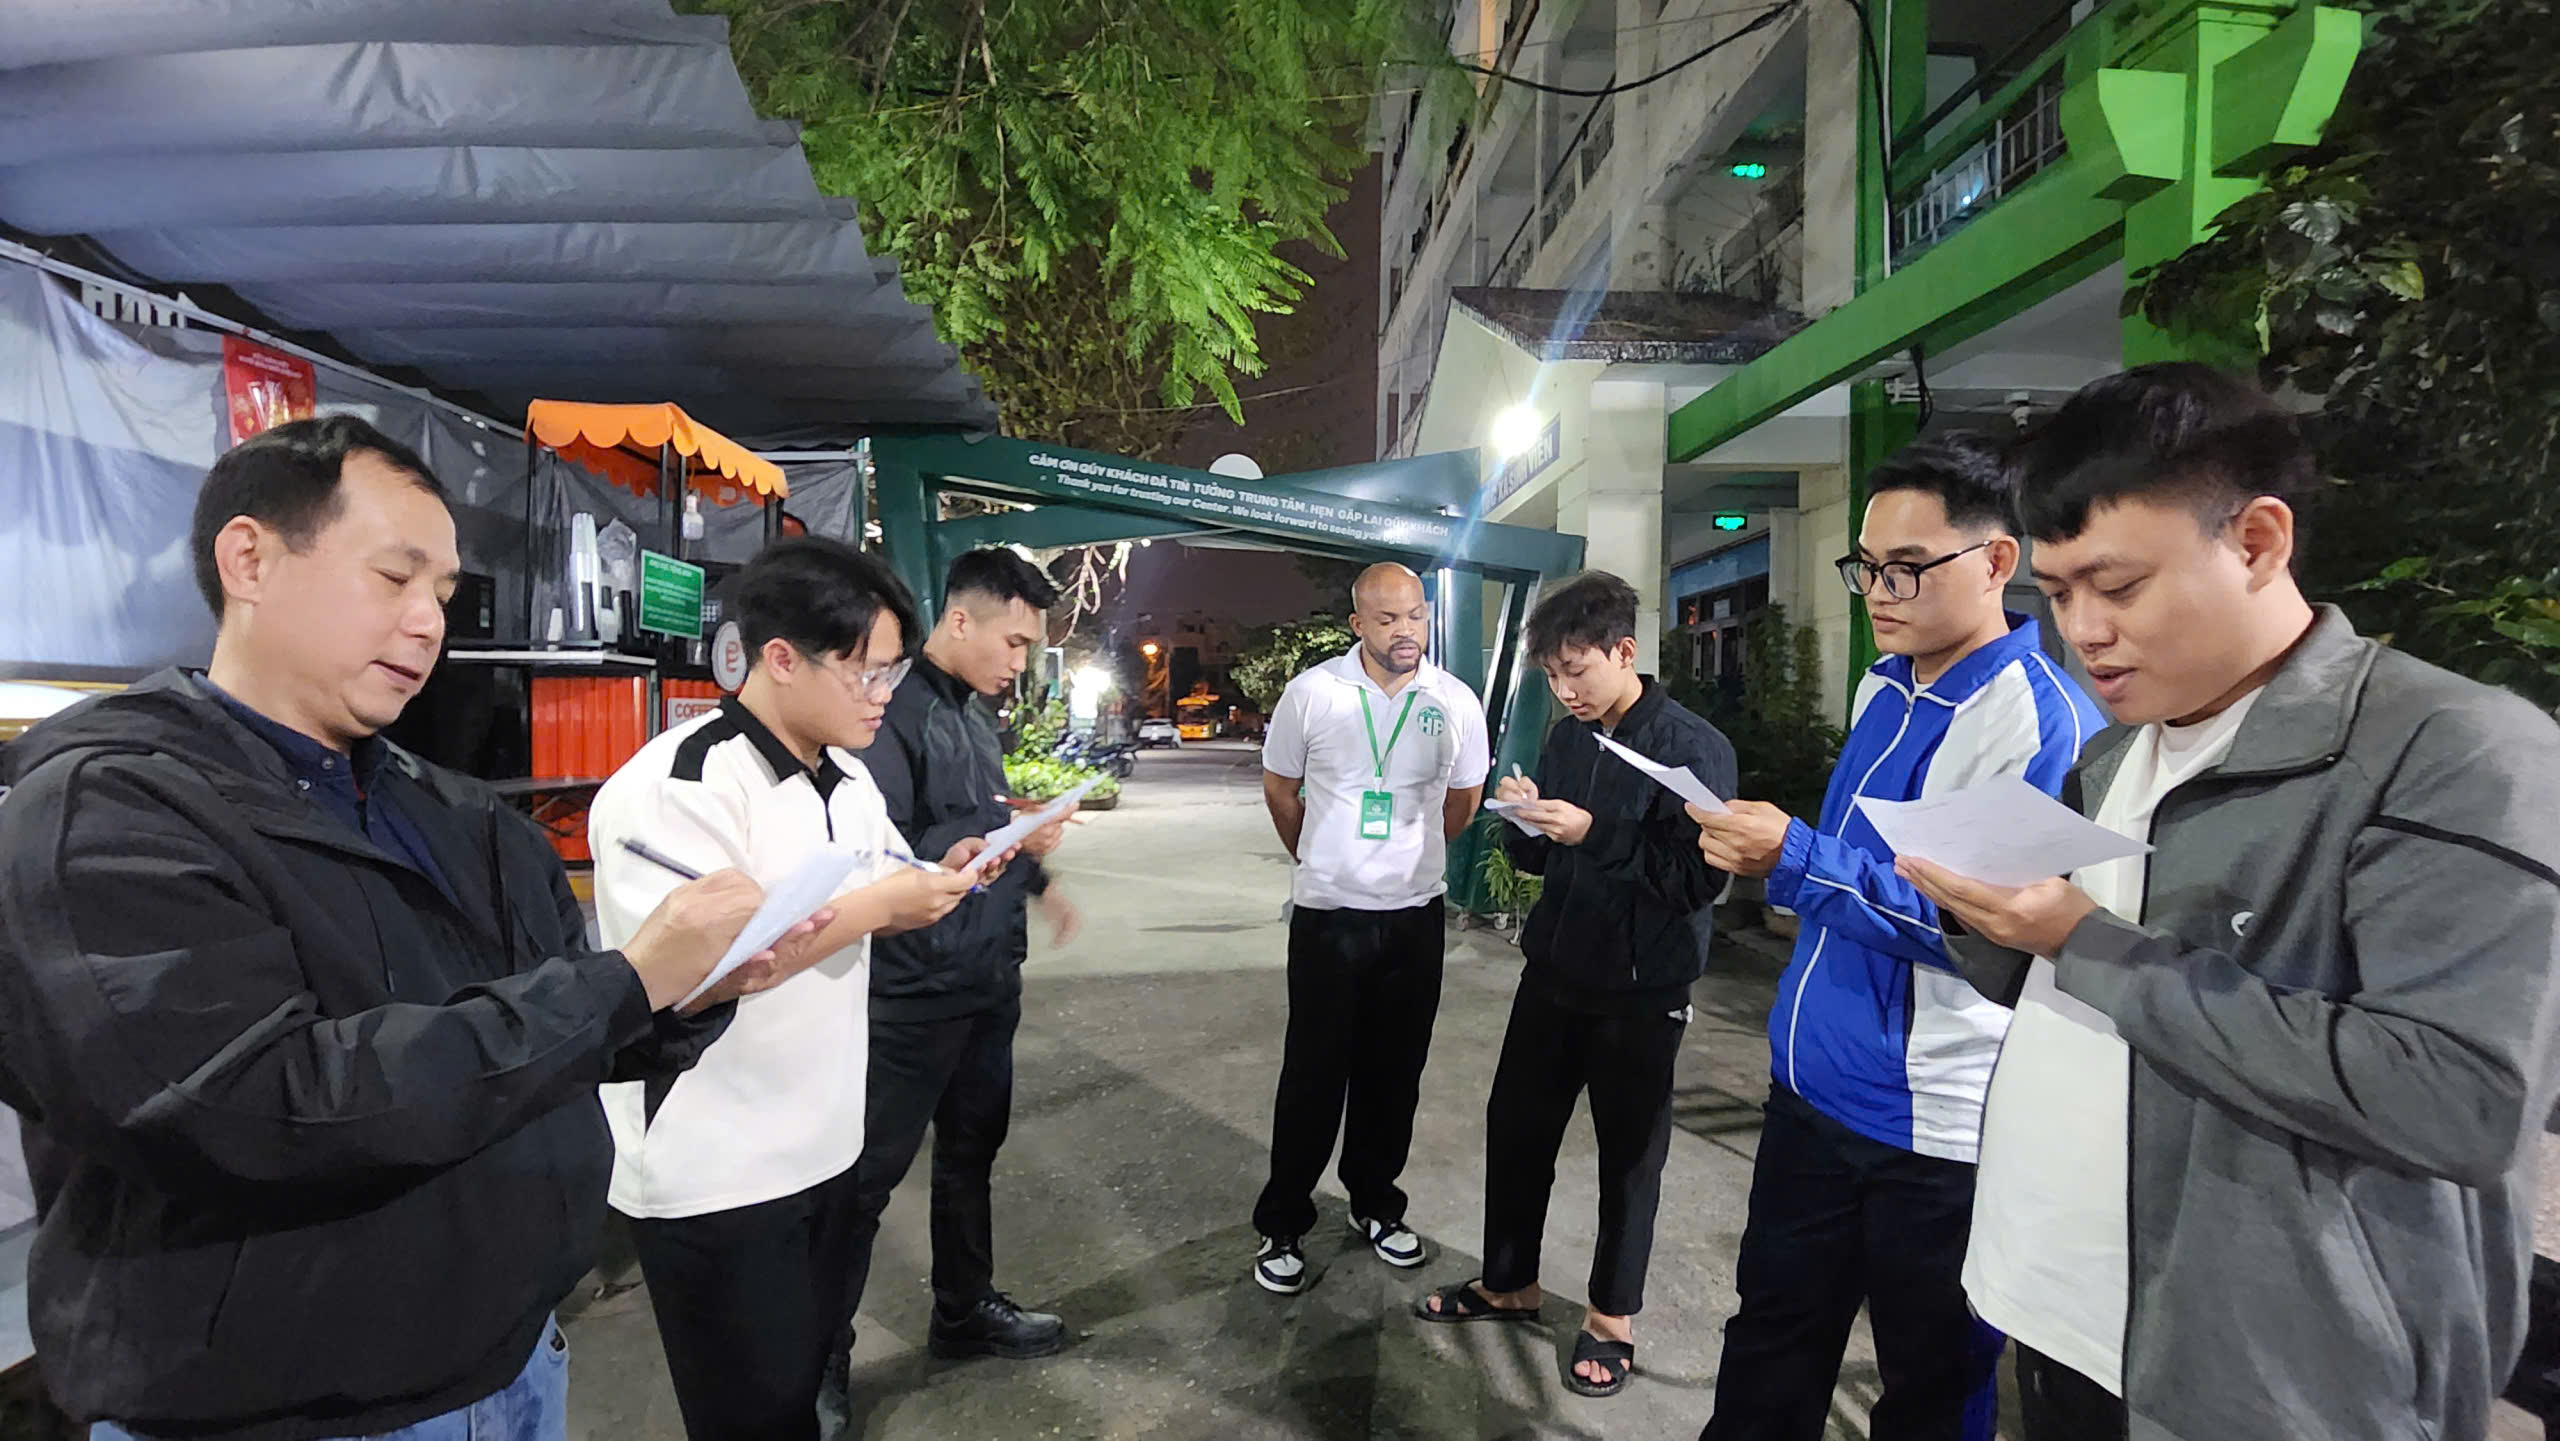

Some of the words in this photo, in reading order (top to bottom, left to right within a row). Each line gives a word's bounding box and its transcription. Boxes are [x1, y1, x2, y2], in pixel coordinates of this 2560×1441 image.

[1057, 473, 1091, 489] Thank
[1090, 482, 1112, 492] you
[1112, 484, 1129, 495] for
[1130, 488, 1172, 505] trusting
[1172, 497, 1192, 506] our
[1232, 504, 1250, 517] We
[1250, 508, 1274, 521] look
[1274, 513, 1318, 530] forward
[1317, 522, 1329, 531] to
[1329, 524, 1362, 540] seeing
[1106, 468, 1149, 485] KHÁCH
[1150, 474, 1168, 489] ĐÃ
[1238, 491, 1280, 508] TRUNG
[1310, 504, 1334, 518] HẸN
[1338, 508, 1362, 524] GẶP
